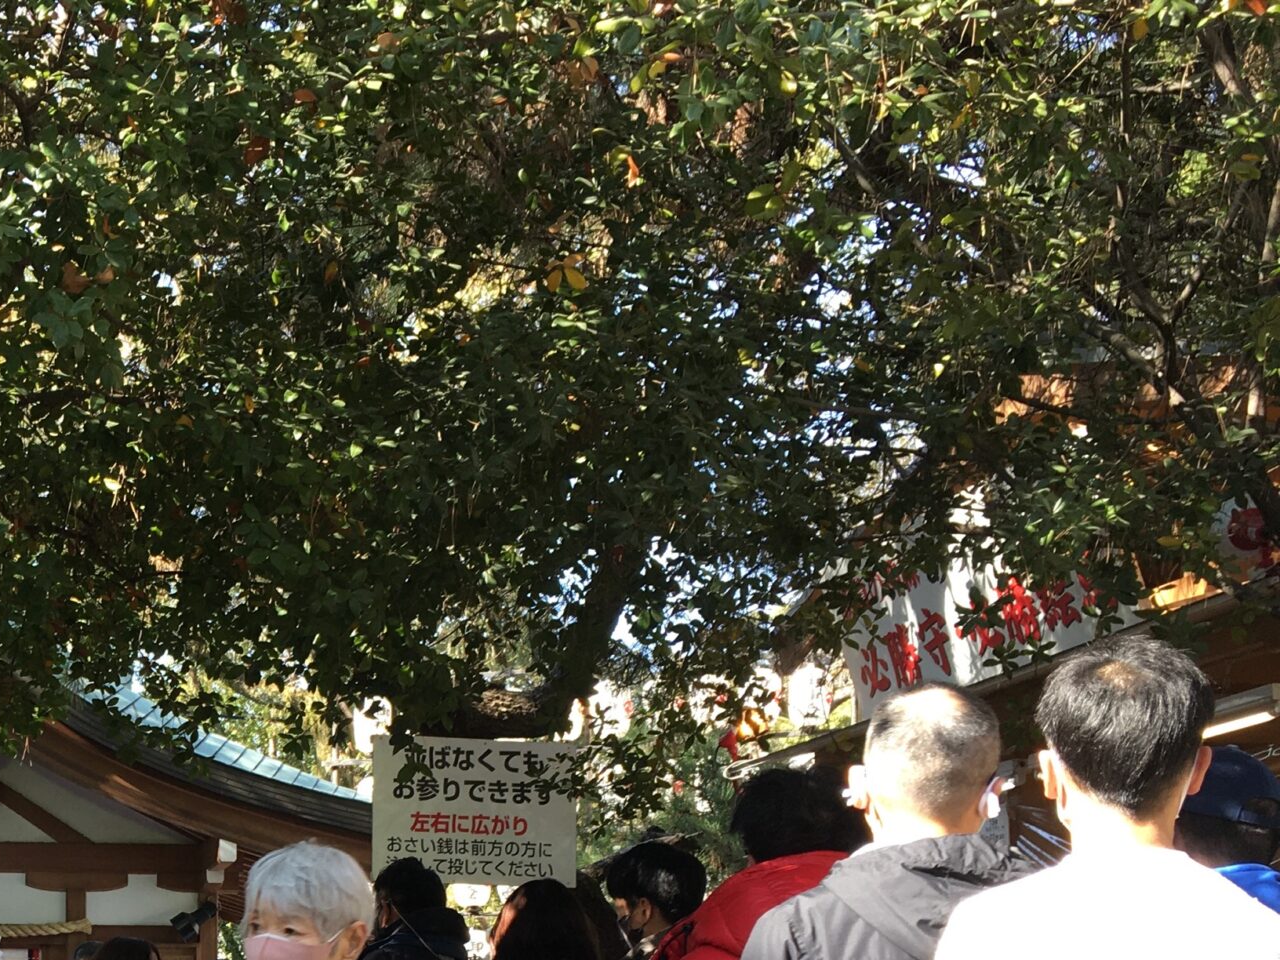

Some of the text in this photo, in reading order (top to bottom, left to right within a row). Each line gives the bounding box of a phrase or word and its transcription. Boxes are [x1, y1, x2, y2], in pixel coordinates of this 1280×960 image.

[392, 776, 551, 805] お参りできます
[410, 811, 529, 836] 左右に広がり
[387, 836, 553, 858] おさい銭は前方の方に
